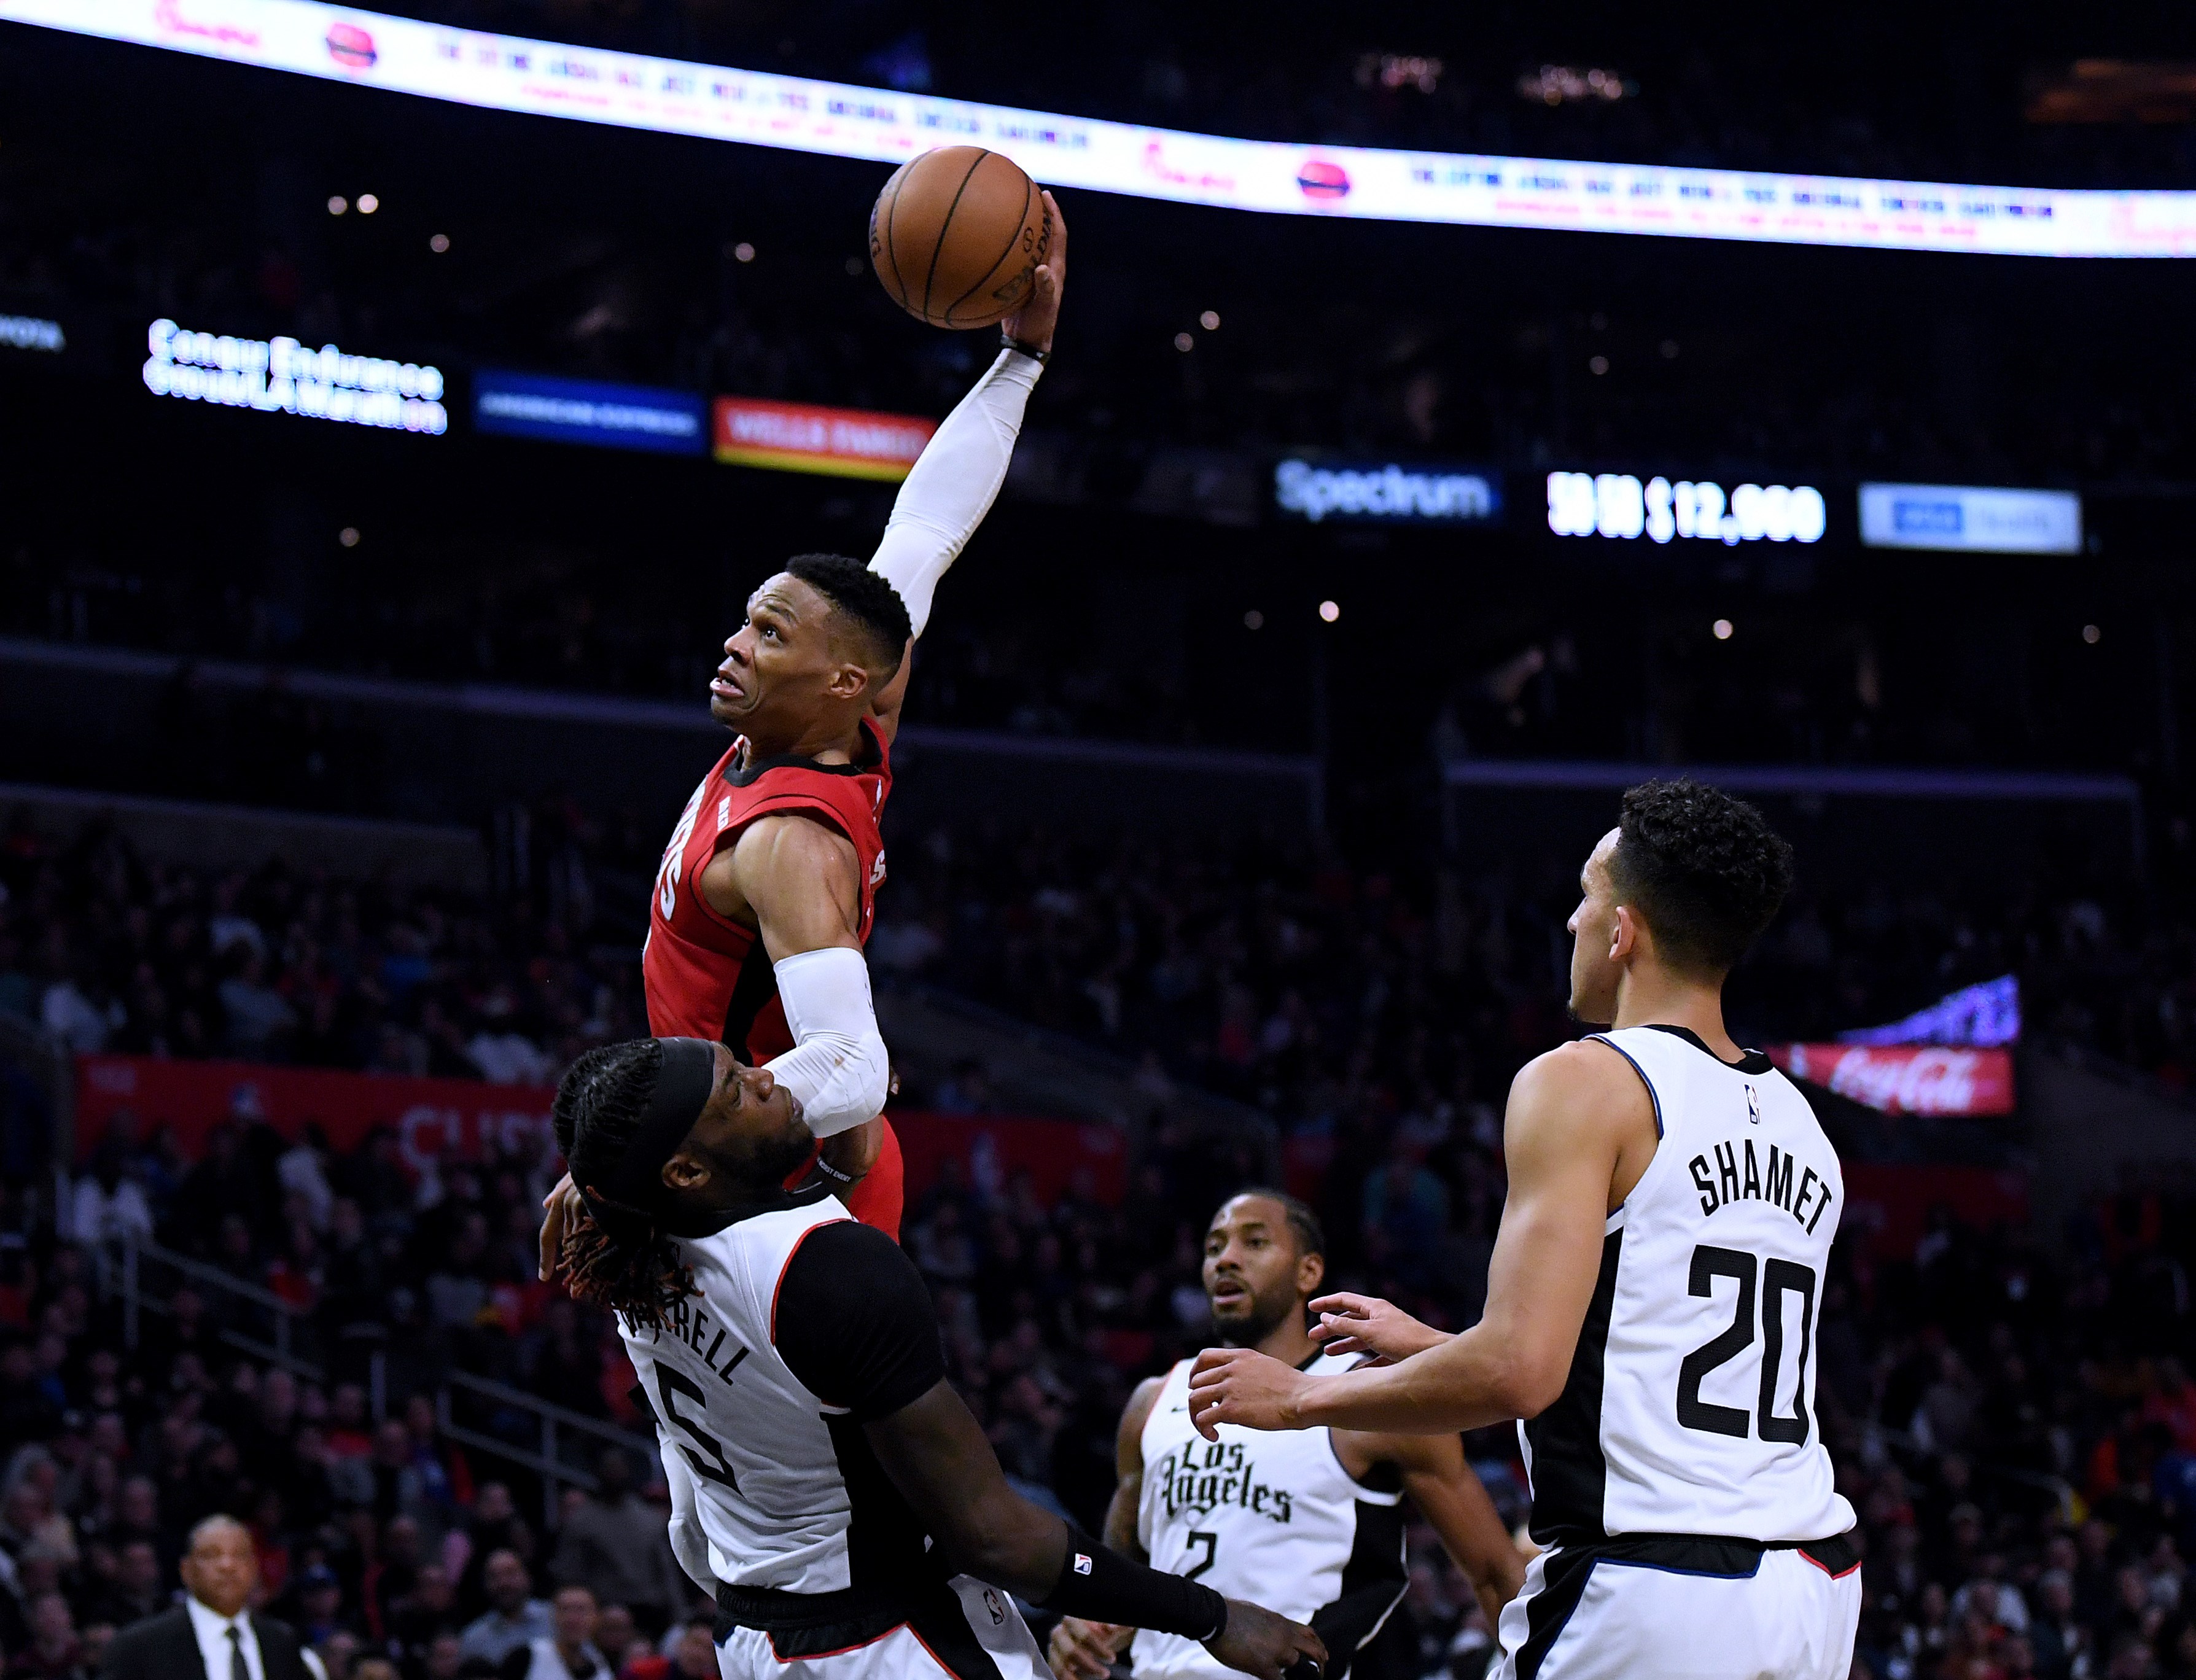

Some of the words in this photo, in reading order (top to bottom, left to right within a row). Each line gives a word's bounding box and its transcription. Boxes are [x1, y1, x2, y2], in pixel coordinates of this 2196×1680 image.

[1276, 459, 1491, 522] Spectrum
[1688, 1138, 1832, 1236] SHAMET
[1676, 1244, 1816, 1450] 20
[653, 1358, 746, 1499] 5
[1181, 1438, 1247, 1474] Los
[1161, 1455, 1293, 1523] Angeles
[1185, 1530, 1218, 1580] 2
